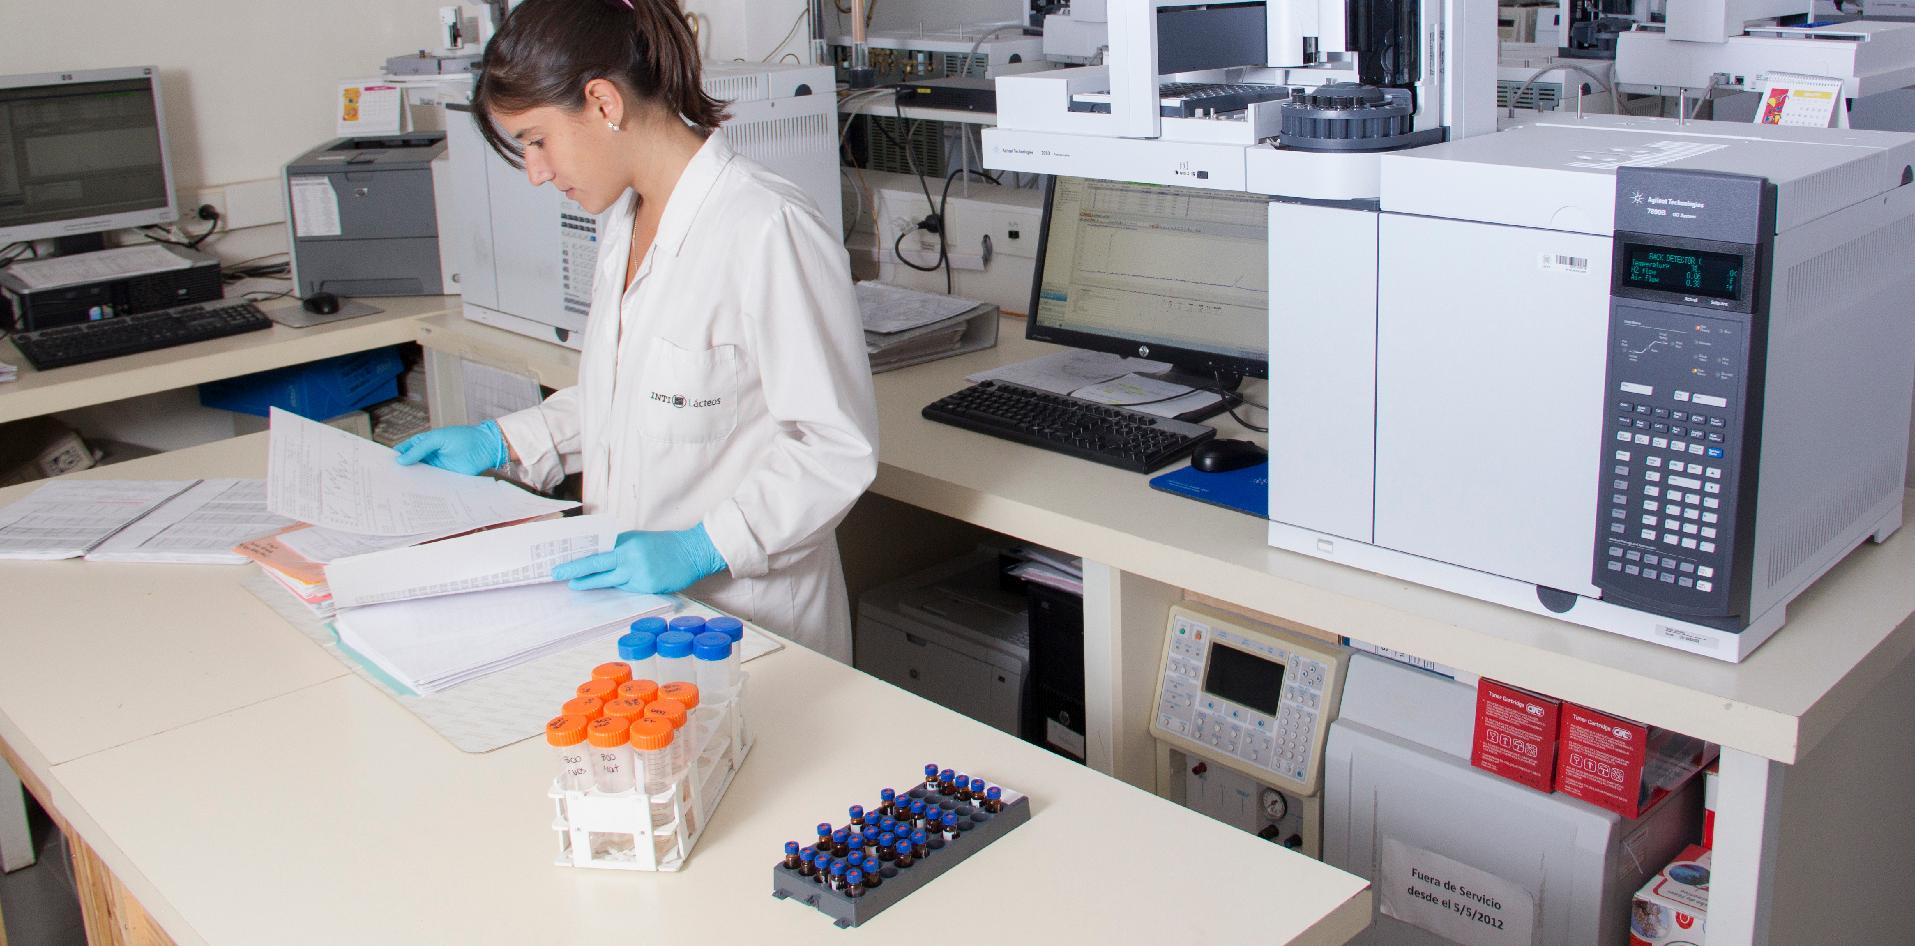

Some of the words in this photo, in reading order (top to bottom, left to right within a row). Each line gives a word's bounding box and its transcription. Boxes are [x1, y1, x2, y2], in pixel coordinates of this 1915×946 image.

[1647, 196, 1667, 205] Agilent
[1668, 198, 1704, 208] Technologies
[650, 391, 671, 404] INTI
[1411, 867, 1441, 887] Fuera
[1443, 880, 1457, 893] de
[1459, 886, 1502, 910] Servicio
[1407, 886, 1439, 905] desde
[1441, 898, 1451, 909] el
[1453, 902, 1504, 930] 5/5/2012
